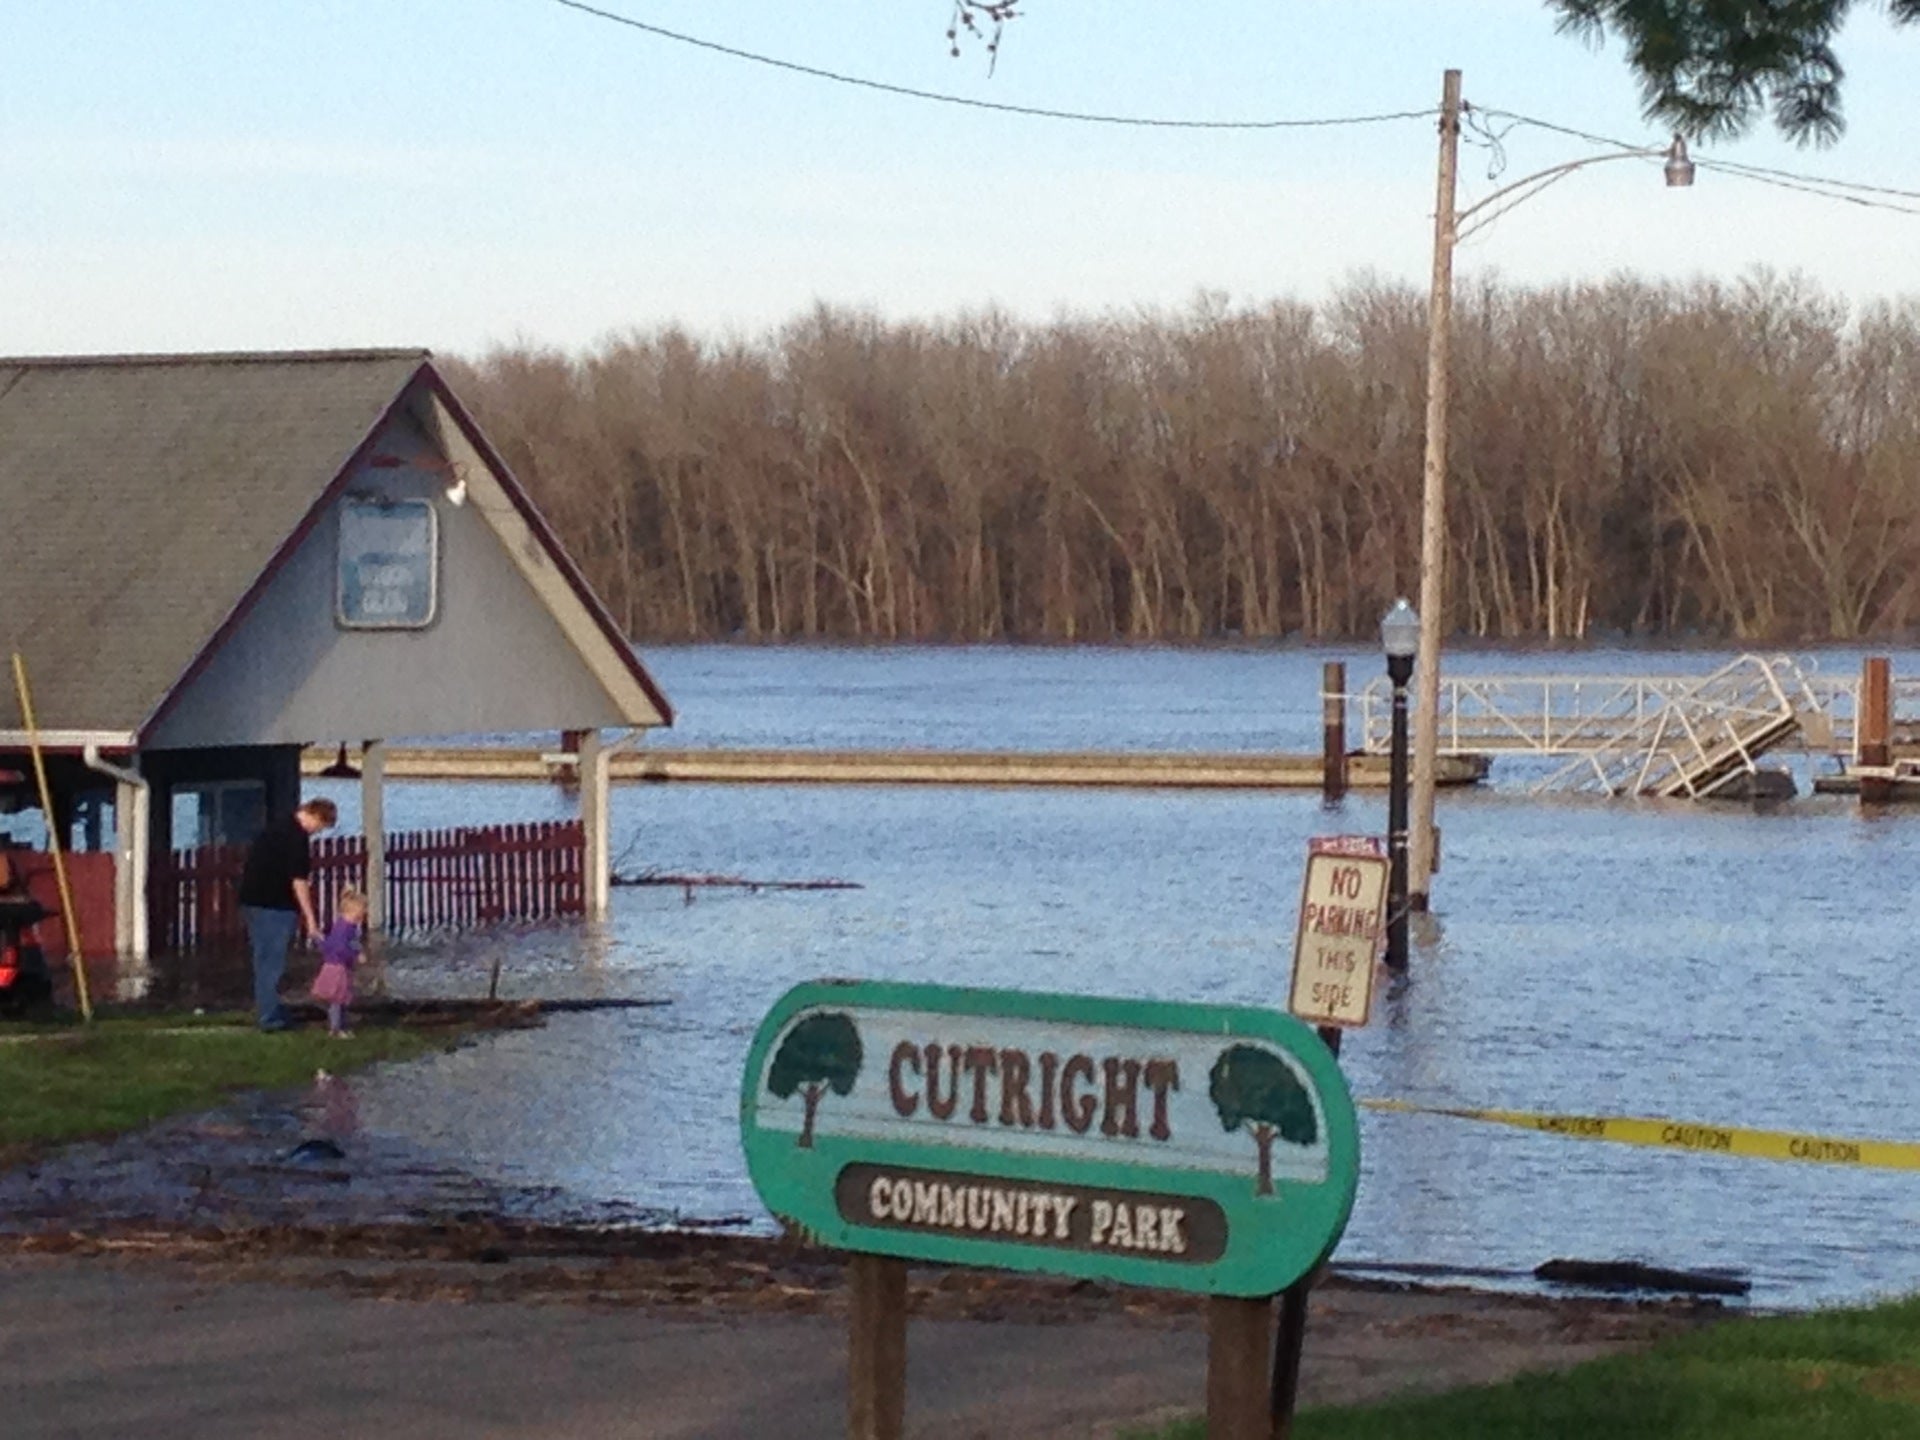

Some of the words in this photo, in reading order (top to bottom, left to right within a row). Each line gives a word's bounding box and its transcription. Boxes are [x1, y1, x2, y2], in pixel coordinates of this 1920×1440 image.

[1330, 867, 1361, 899] NO
[1306, 903, 1378, 939] PARKING
[1318, 947, 1355, 972] THIS
[1311, 982, 1351, 1007] SIDE
[890, 1040, 1180, 1141] CUTRIGHT
[1661, 1125, 1731, 1150] CAUTION
[1789, 1138, 1861, 1161] CAUTION
[870, 1177, 1076, 1239] COMMUNITY
[1090, 1200, 1186, 1253] PARK
